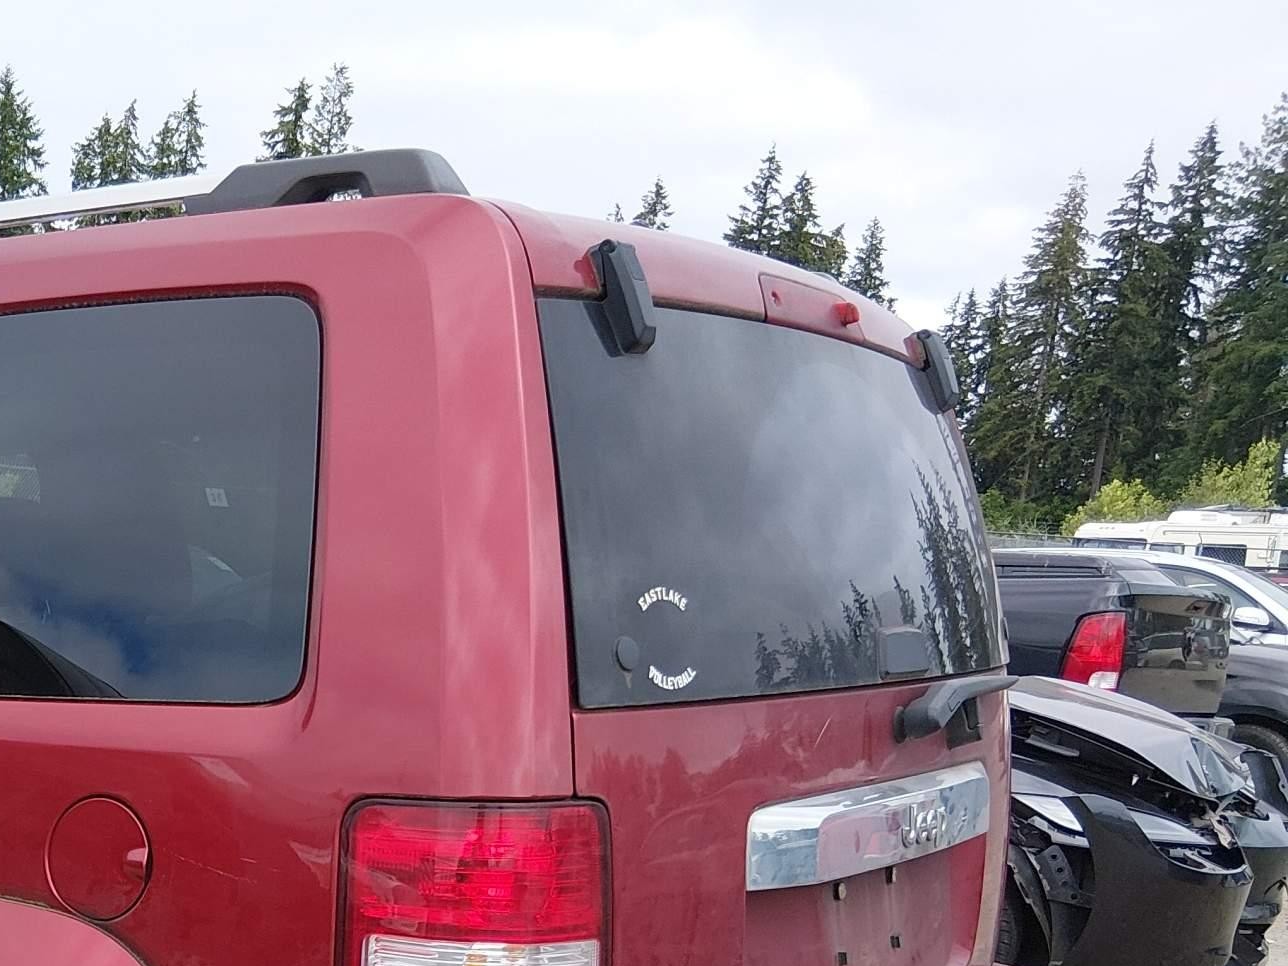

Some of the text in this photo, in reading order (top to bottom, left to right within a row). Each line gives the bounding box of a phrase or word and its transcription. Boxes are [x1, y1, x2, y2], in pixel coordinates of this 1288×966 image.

[637, 586, 688, 612] EASTLAKE
[648, 665, 697, 690] VOLLEYBALL
[902, 803, 948, 848] Jeep
